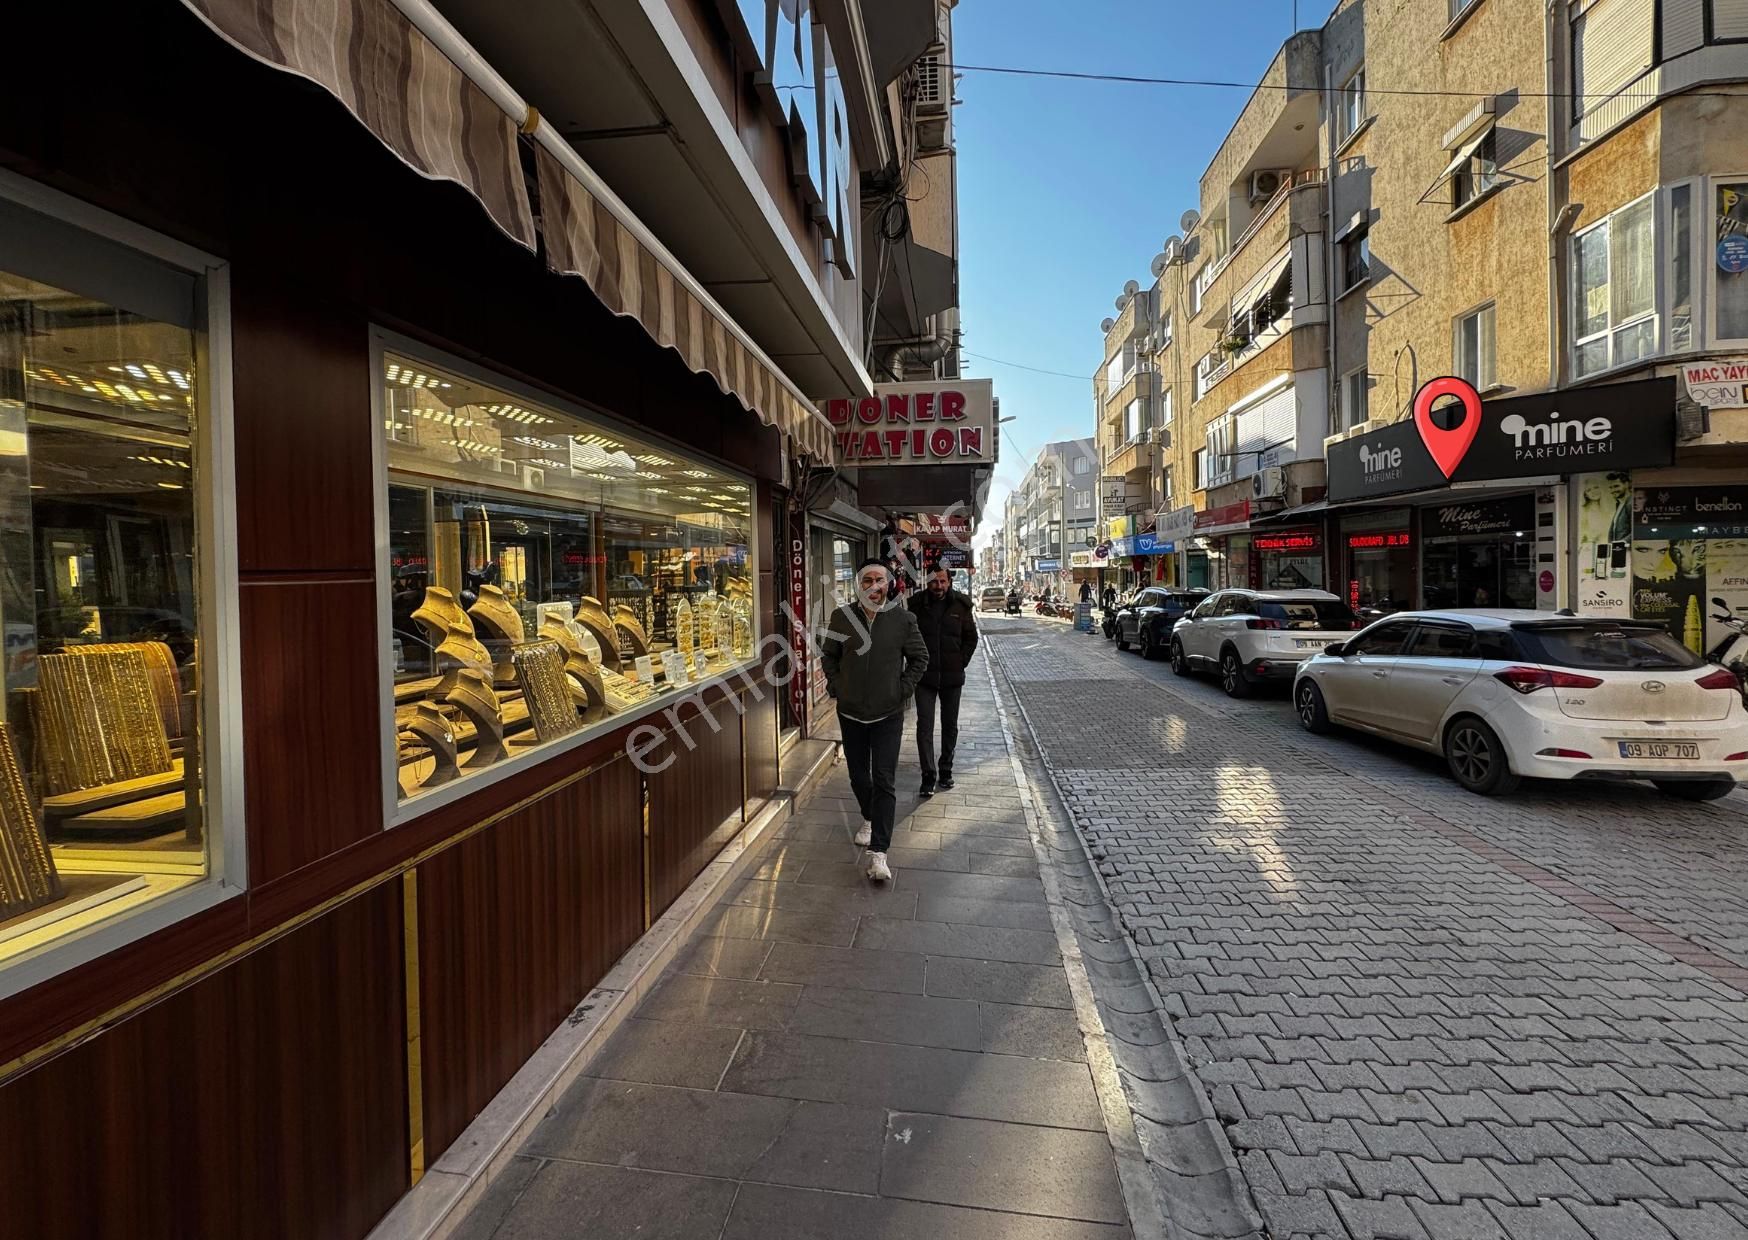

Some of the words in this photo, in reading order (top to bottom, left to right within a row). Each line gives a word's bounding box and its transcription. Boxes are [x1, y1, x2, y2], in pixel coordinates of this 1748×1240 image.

[1502, 411, 1612, 448] mine
[836, 426, 984, 460] TATION
[1515, 440, 1613, 461] PARFÜMERİ
[1360, 442, 1402, 474] mine
[1438, 506, 1481, 523] Mine
[916, 526, 940, 534] KAAP
[792, 539, 803, 606] Döner
[1627, 744, 1642, 757] 09
[1674, 744, 1695, 757] 707
